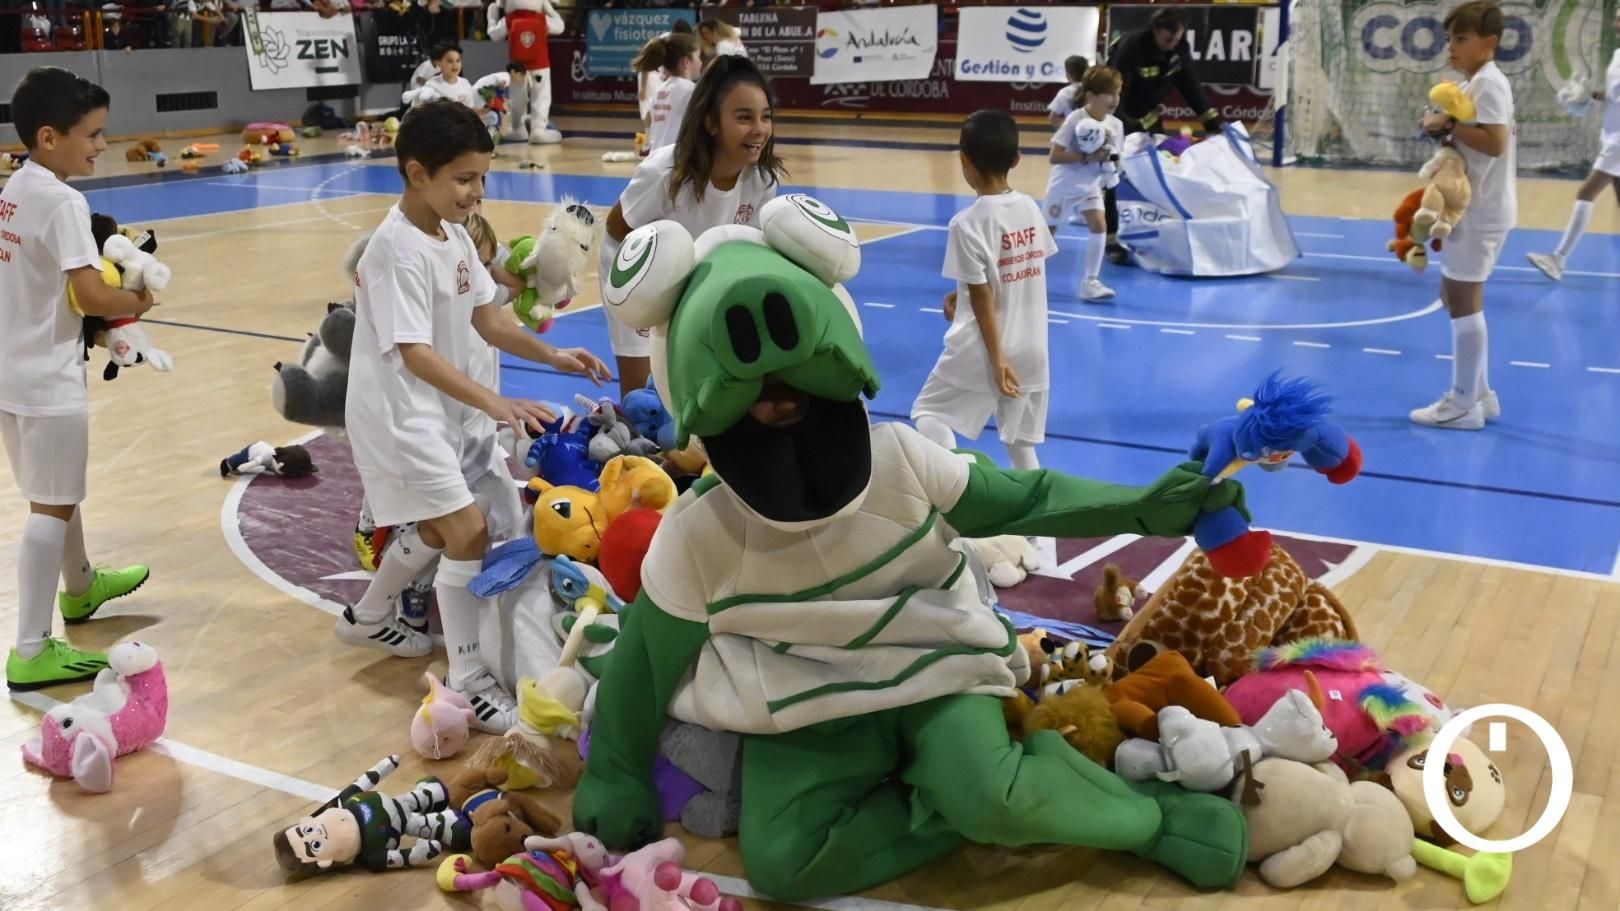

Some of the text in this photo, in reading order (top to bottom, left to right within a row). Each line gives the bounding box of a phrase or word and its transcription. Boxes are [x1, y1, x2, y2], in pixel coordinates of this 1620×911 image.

[614, 11, 670, 28] vázquez
[739, 13, 778, 23] TABERNA
[614, 28, 668, 40] fisioter
[752, 26, 763, 37] DE
[765, 27, 776, 37] LA
[846, 27, 920, 49] Andalucía
[296, 38, 349, 59] ZEN
[378, 35, 399, 46] GRUPO
[961, 59, 1020, 75] Gestión
[1026, 64, 1035, 78] y
[1002, 226, 1035, 250] STAFF
